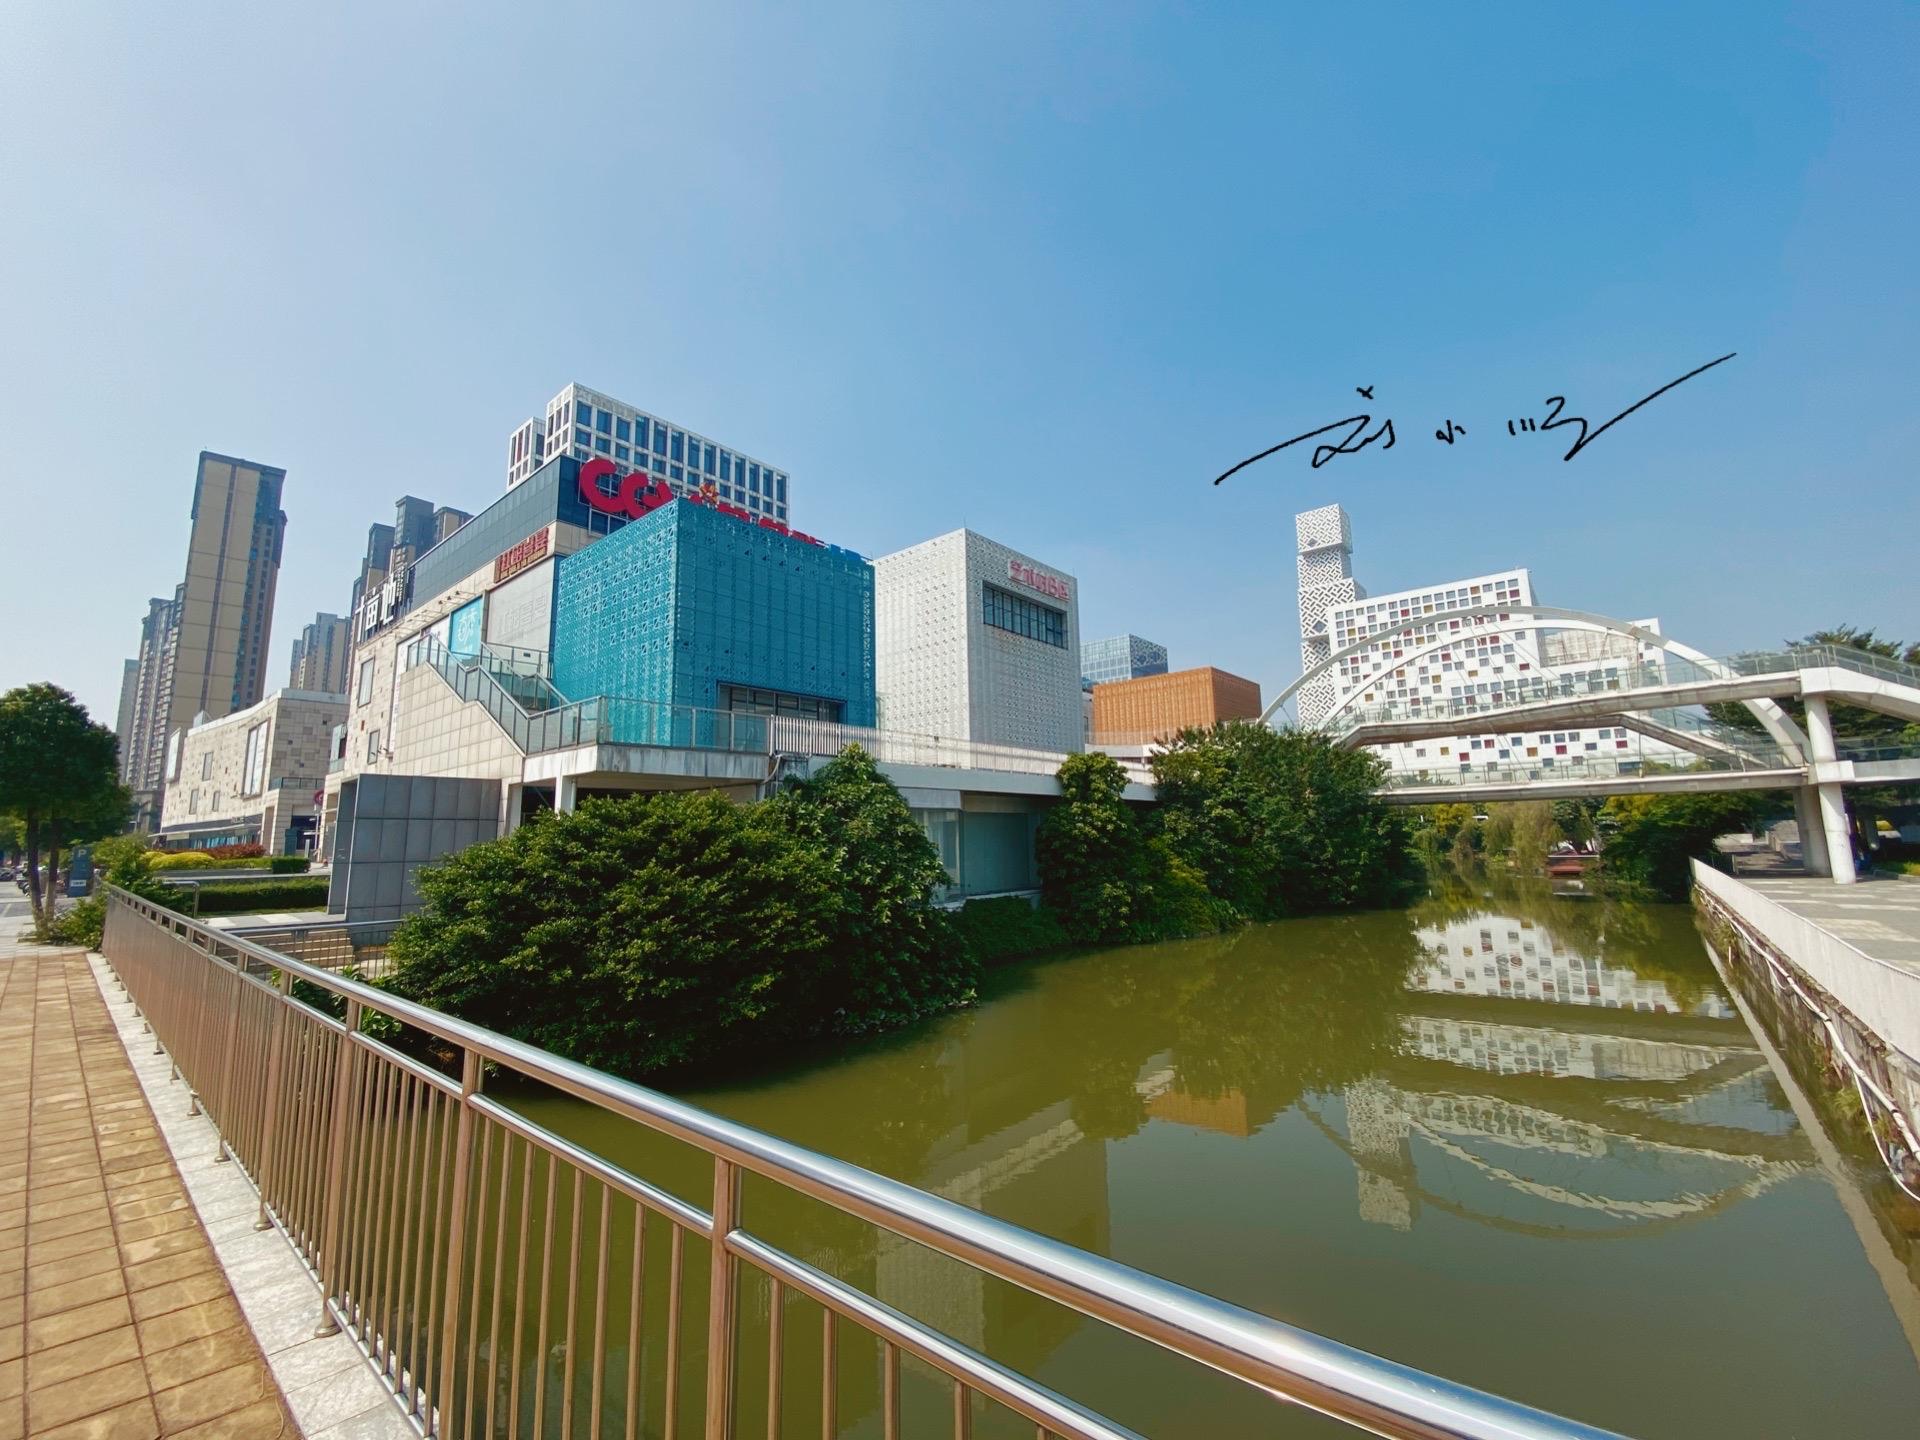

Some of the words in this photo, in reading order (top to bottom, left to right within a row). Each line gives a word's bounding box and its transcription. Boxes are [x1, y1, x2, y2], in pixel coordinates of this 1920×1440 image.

[354, 571, 397, 642] 十亩地
[78, 849, 87, 858] P
